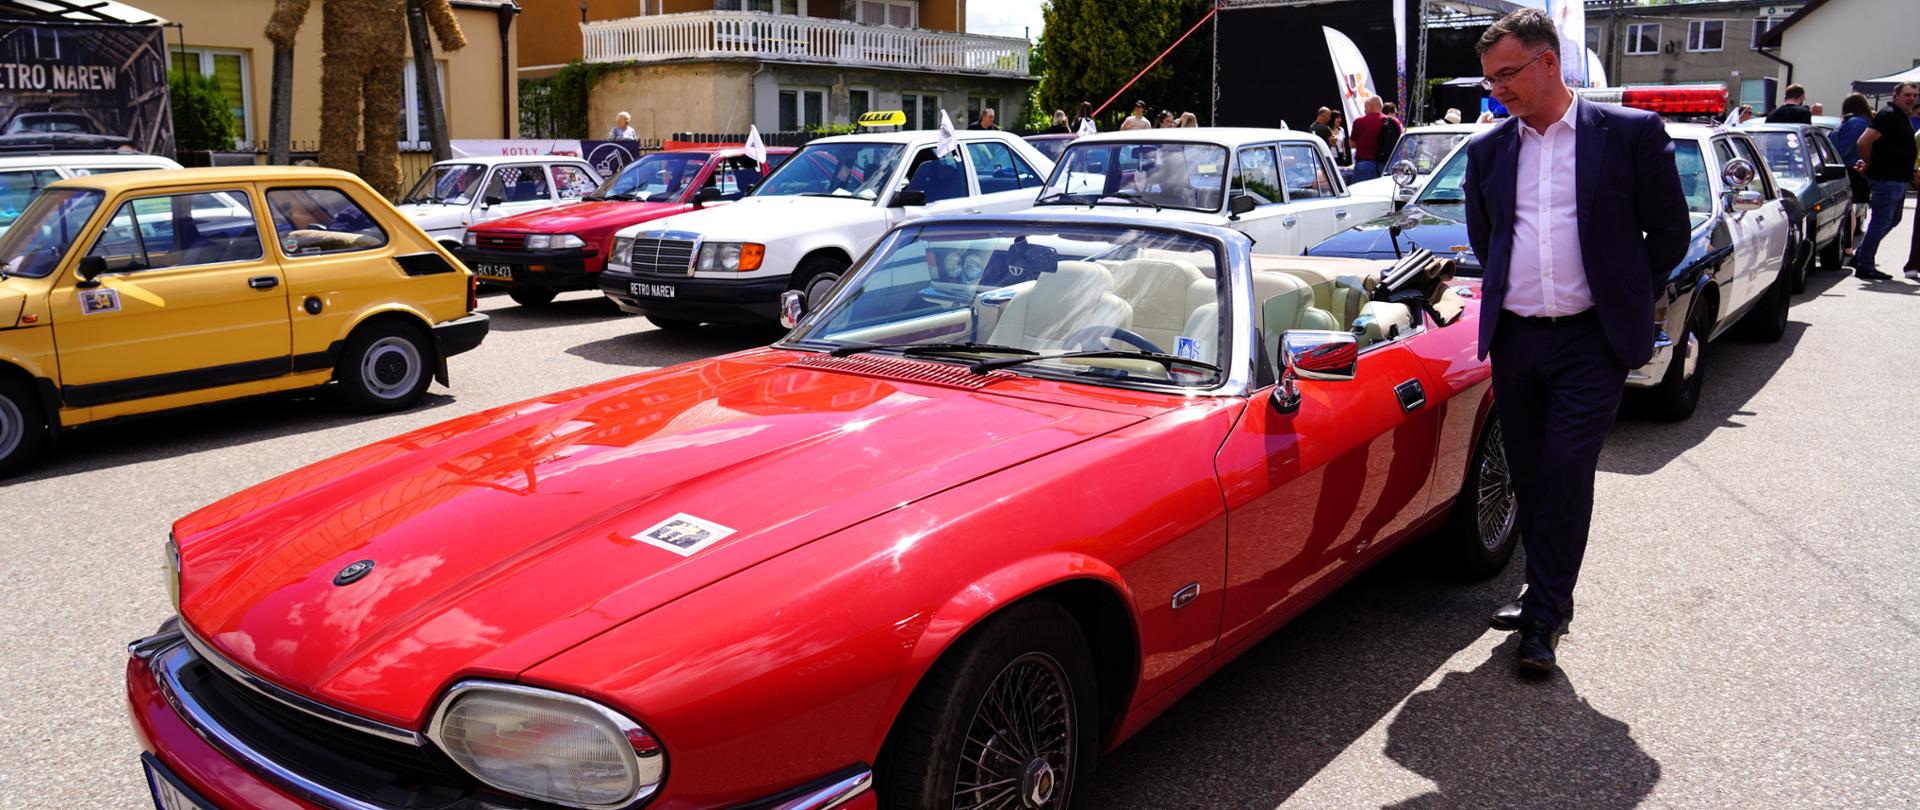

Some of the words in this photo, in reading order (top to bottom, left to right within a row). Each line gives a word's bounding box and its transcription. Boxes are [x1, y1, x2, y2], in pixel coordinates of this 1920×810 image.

[52, 64, 117, 90] NAREW
[477, 263, 492, 276] BKY
[494, 264, 512, 278] 5423
[630, 282, 650, 296] RETRO
[651, 284, 675, 298] NAREW
